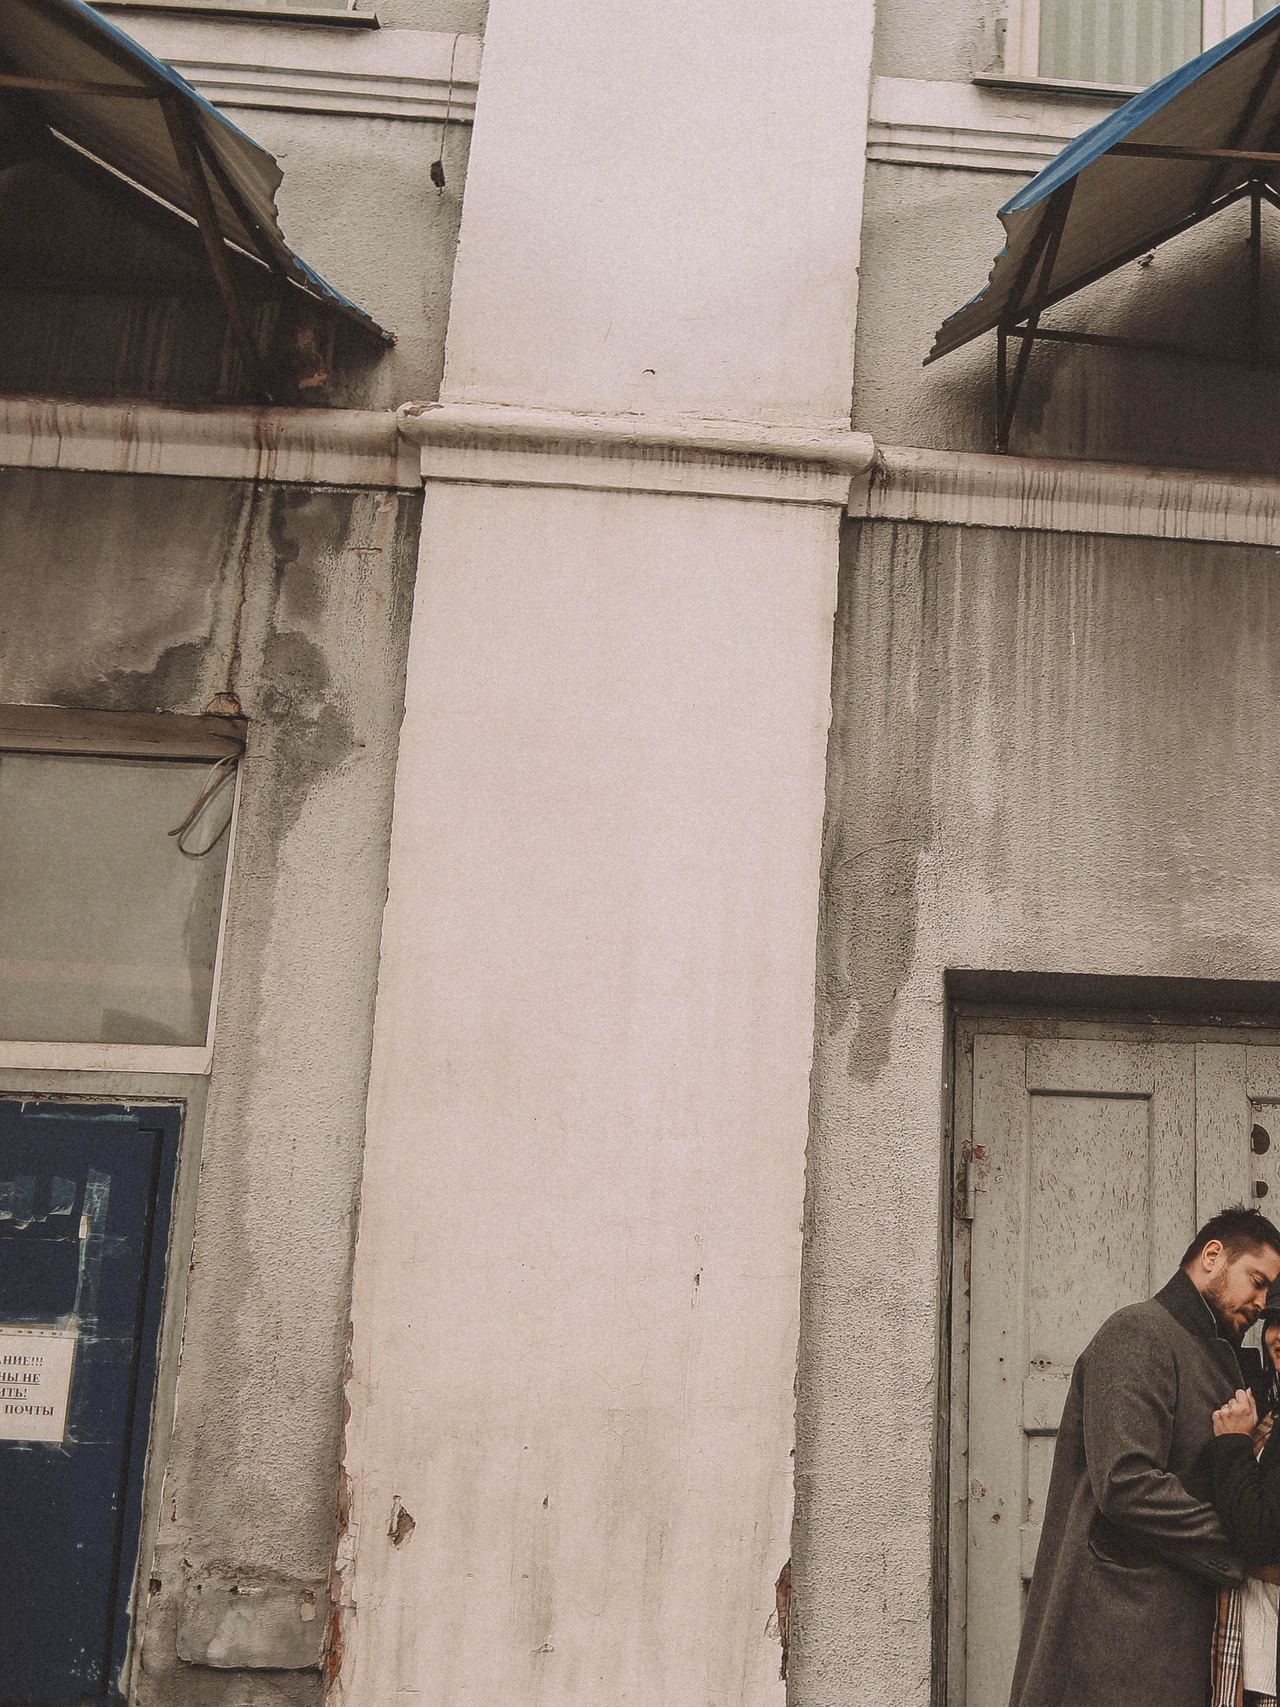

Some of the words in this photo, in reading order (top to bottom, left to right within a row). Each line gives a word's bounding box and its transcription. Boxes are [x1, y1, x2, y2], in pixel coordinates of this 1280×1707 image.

[0, 1355, 43, 1366] НИЕ!!!
[23, 1373, 41, 1383] НЕ
[5, 1404, 55, 1416] ПОЧТЫ
